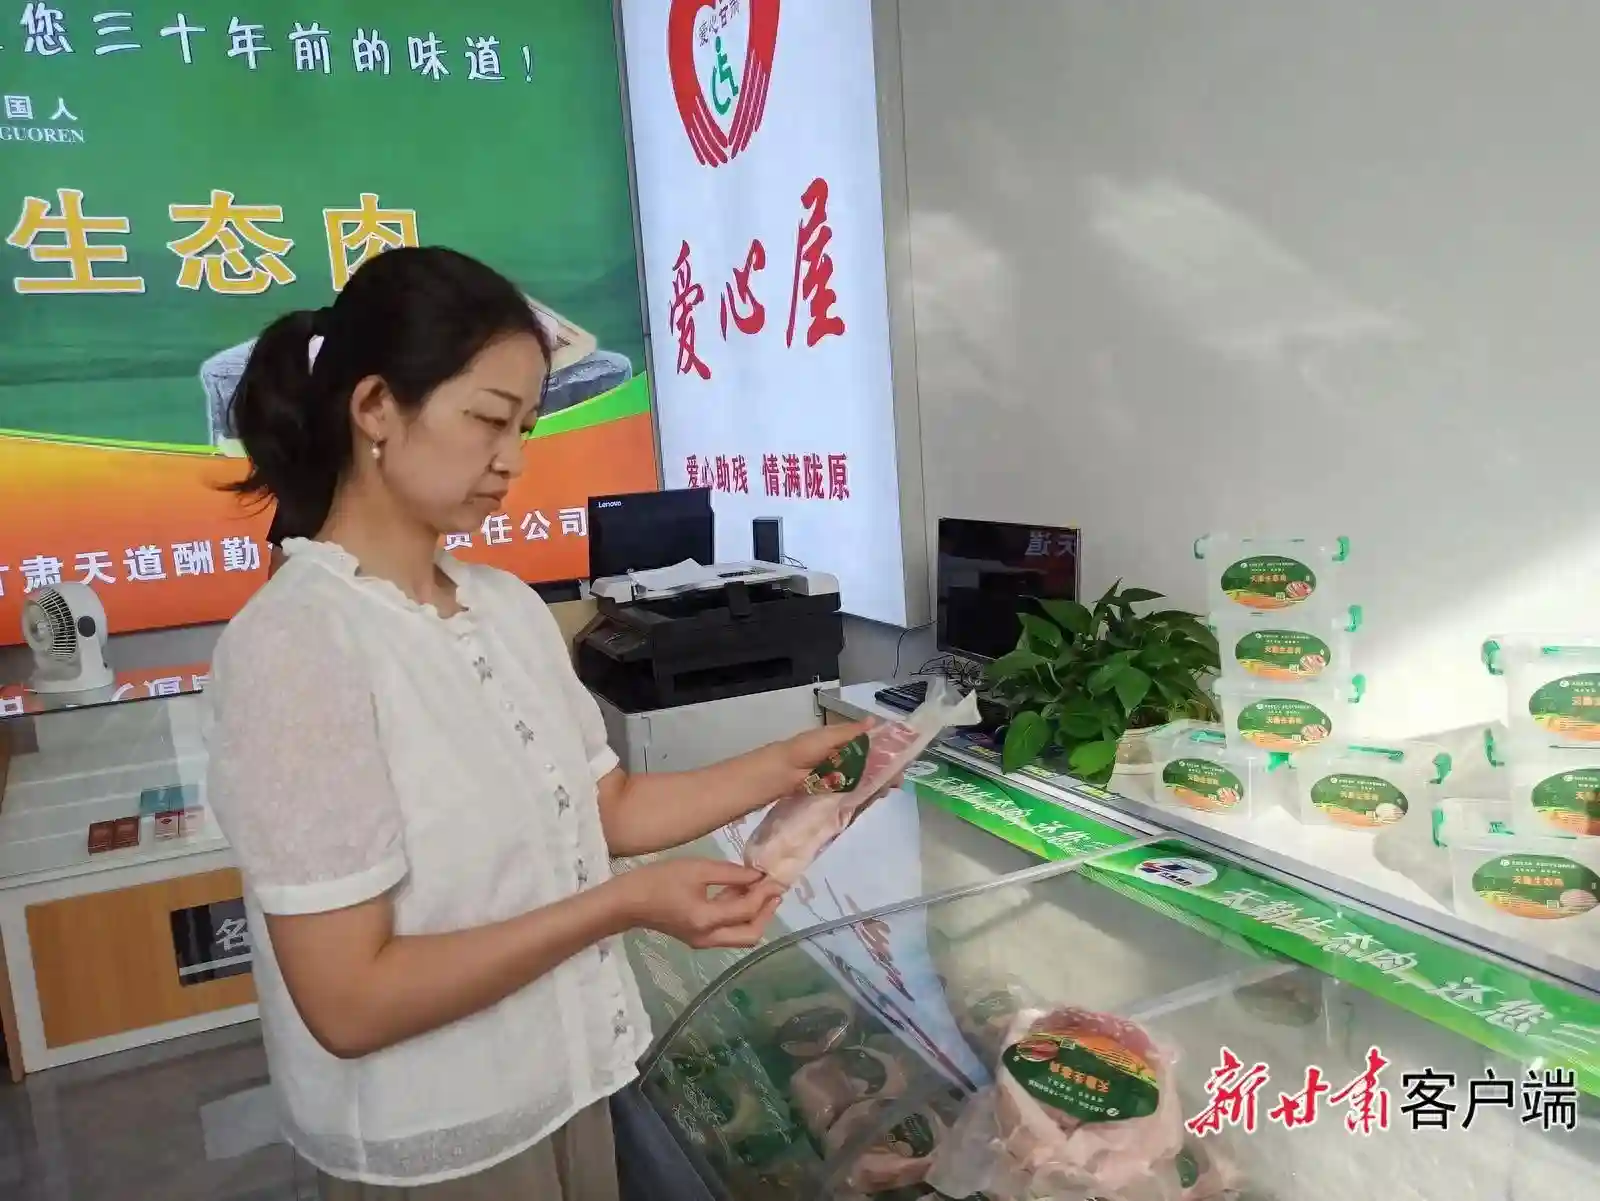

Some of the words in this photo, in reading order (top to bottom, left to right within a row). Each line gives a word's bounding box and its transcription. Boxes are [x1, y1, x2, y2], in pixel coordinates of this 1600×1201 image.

[0, 2, 535, 83] 您三十年前的味道！
[4, 95, 79, 121] 国人
[667, 177, 846, 381] 爱心屋
[598, 500, 623, 509] Lenovo
[686, 453, 749, 495] 爱心助残
[762, 452, 851, 502] 情满陇原
[0, 535, 273, 597] 肃天道酬勤
